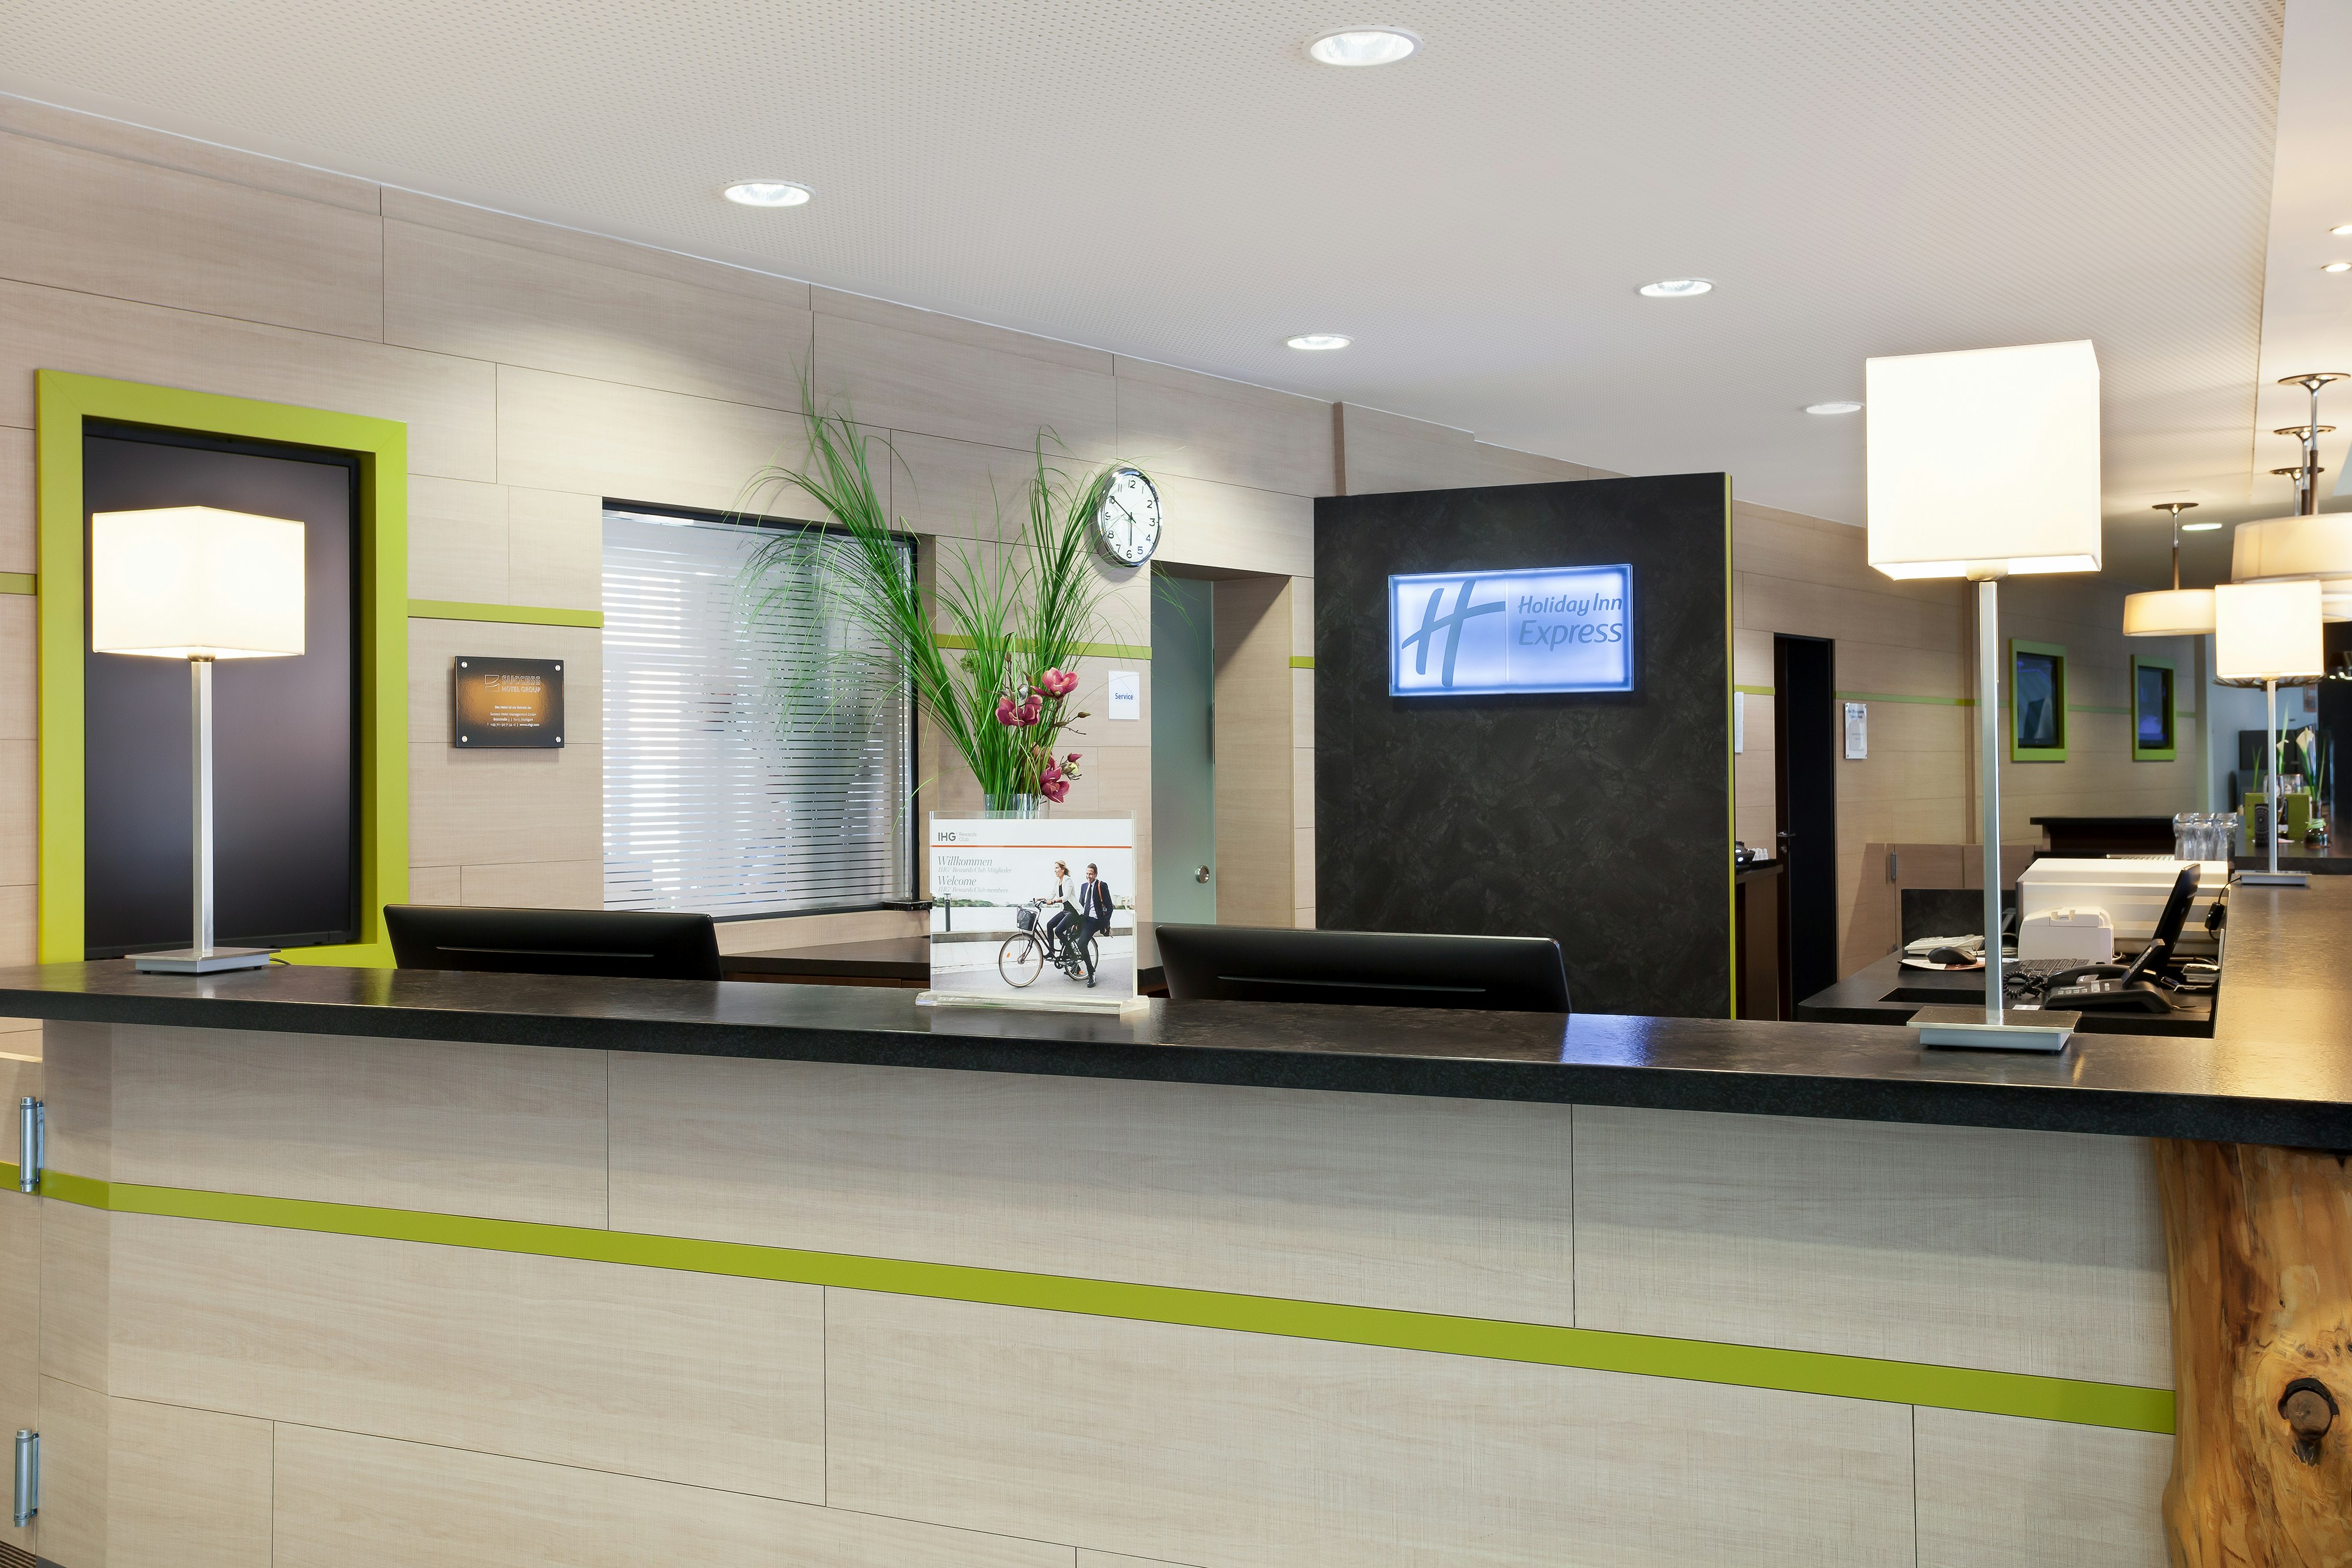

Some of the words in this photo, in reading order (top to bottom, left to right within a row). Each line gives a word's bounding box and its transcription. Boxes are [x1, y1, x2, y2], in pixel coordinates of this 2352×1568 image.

[1117, 483, 1122, 493] 11
[1128, 479, 1136, 489] 12
[1147, 500, 1153, 509] 2
[1149, 518, 1155, 527] 3
[1108, 530, 1114, 539] 8
[1146, 534, 1151, 542] 4
[1115, 544, 1121, 553] 7
[1137, 546, 1144, 555] 5
[1126, 550, 1132, 559] 6
[1518, 594, 1590, 617] Holiday
[1593, 592, 1623, 611] Inn
[1518, 620, 1623, 652] Express
[502, 675, 541, 686] SUCCESS
[938, 832, 956, 841] IHG
[938, 855, 993, 866] Willkommen
[938, 875, 977, 885] Welcome
